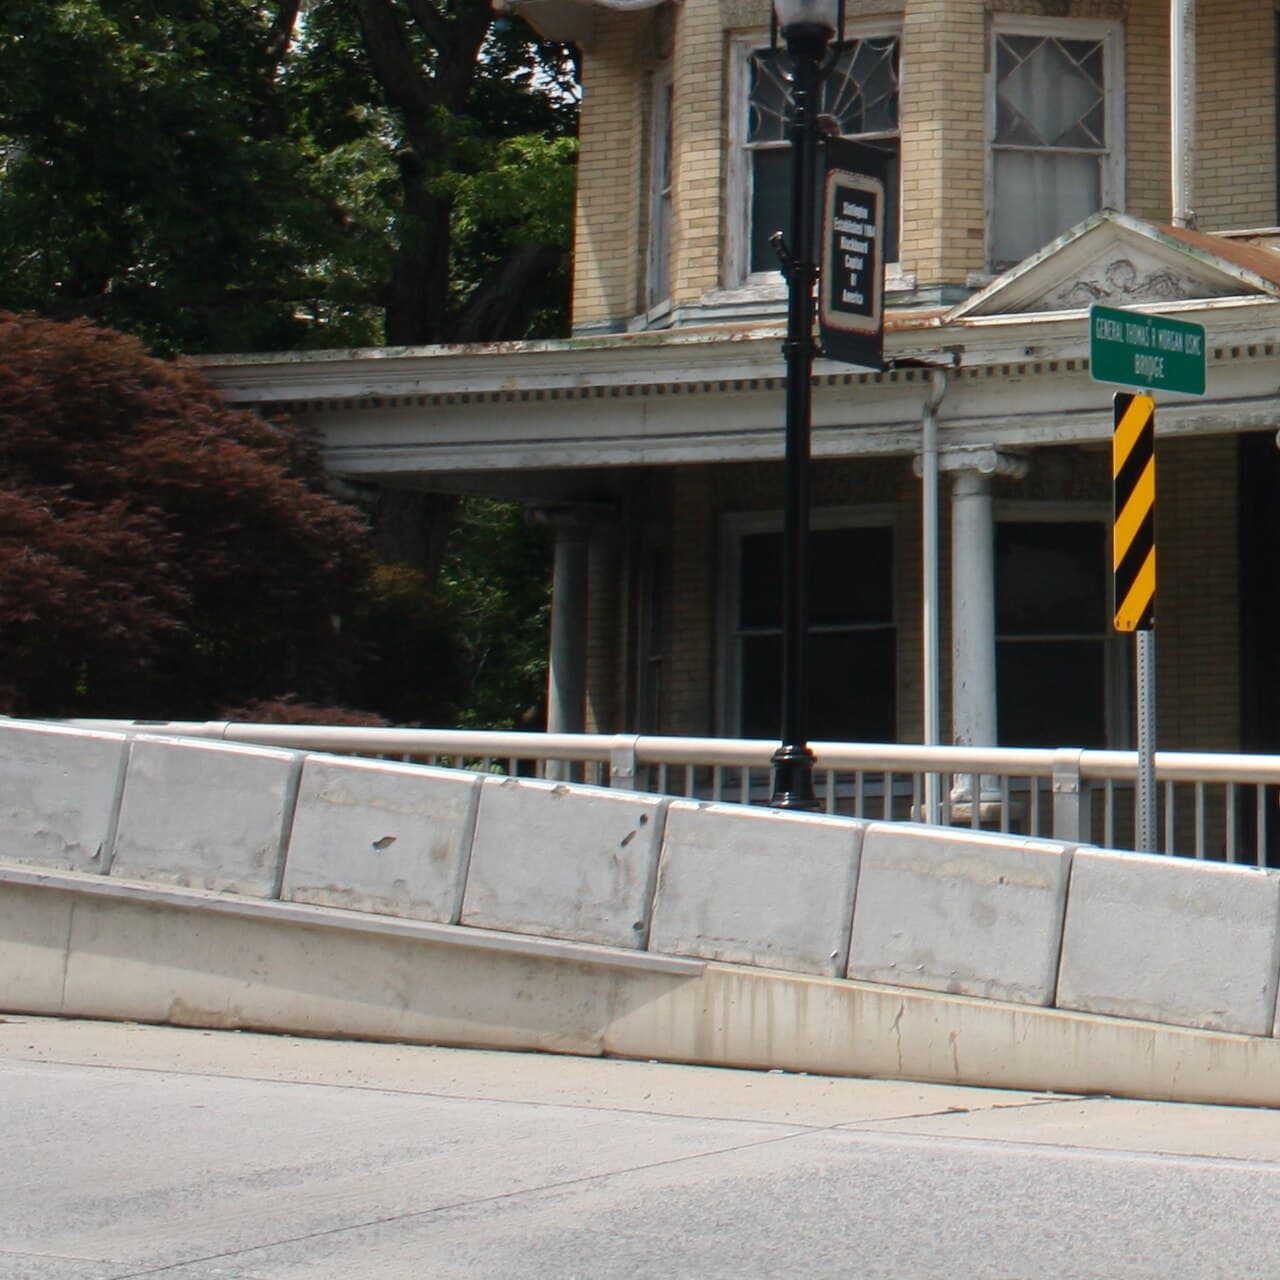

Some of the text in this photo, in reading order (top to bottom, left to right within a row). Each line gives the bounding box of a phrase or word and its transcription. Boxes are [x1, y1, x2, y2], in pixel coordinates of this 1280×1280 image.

[834, 217, 863, 235] Established
[845, 254, 864, 270] Capital
[842, 289, 864, 305] America
[1096, 318, 1124, 343] GENERAL
[1126, 323, 1149, 347] THOMAS
[1158, 329, 1183, 352] MORGAN
[1185, 333, 1201, 355] USMC
[1134, 354, 1164, 378] BRIDGE
